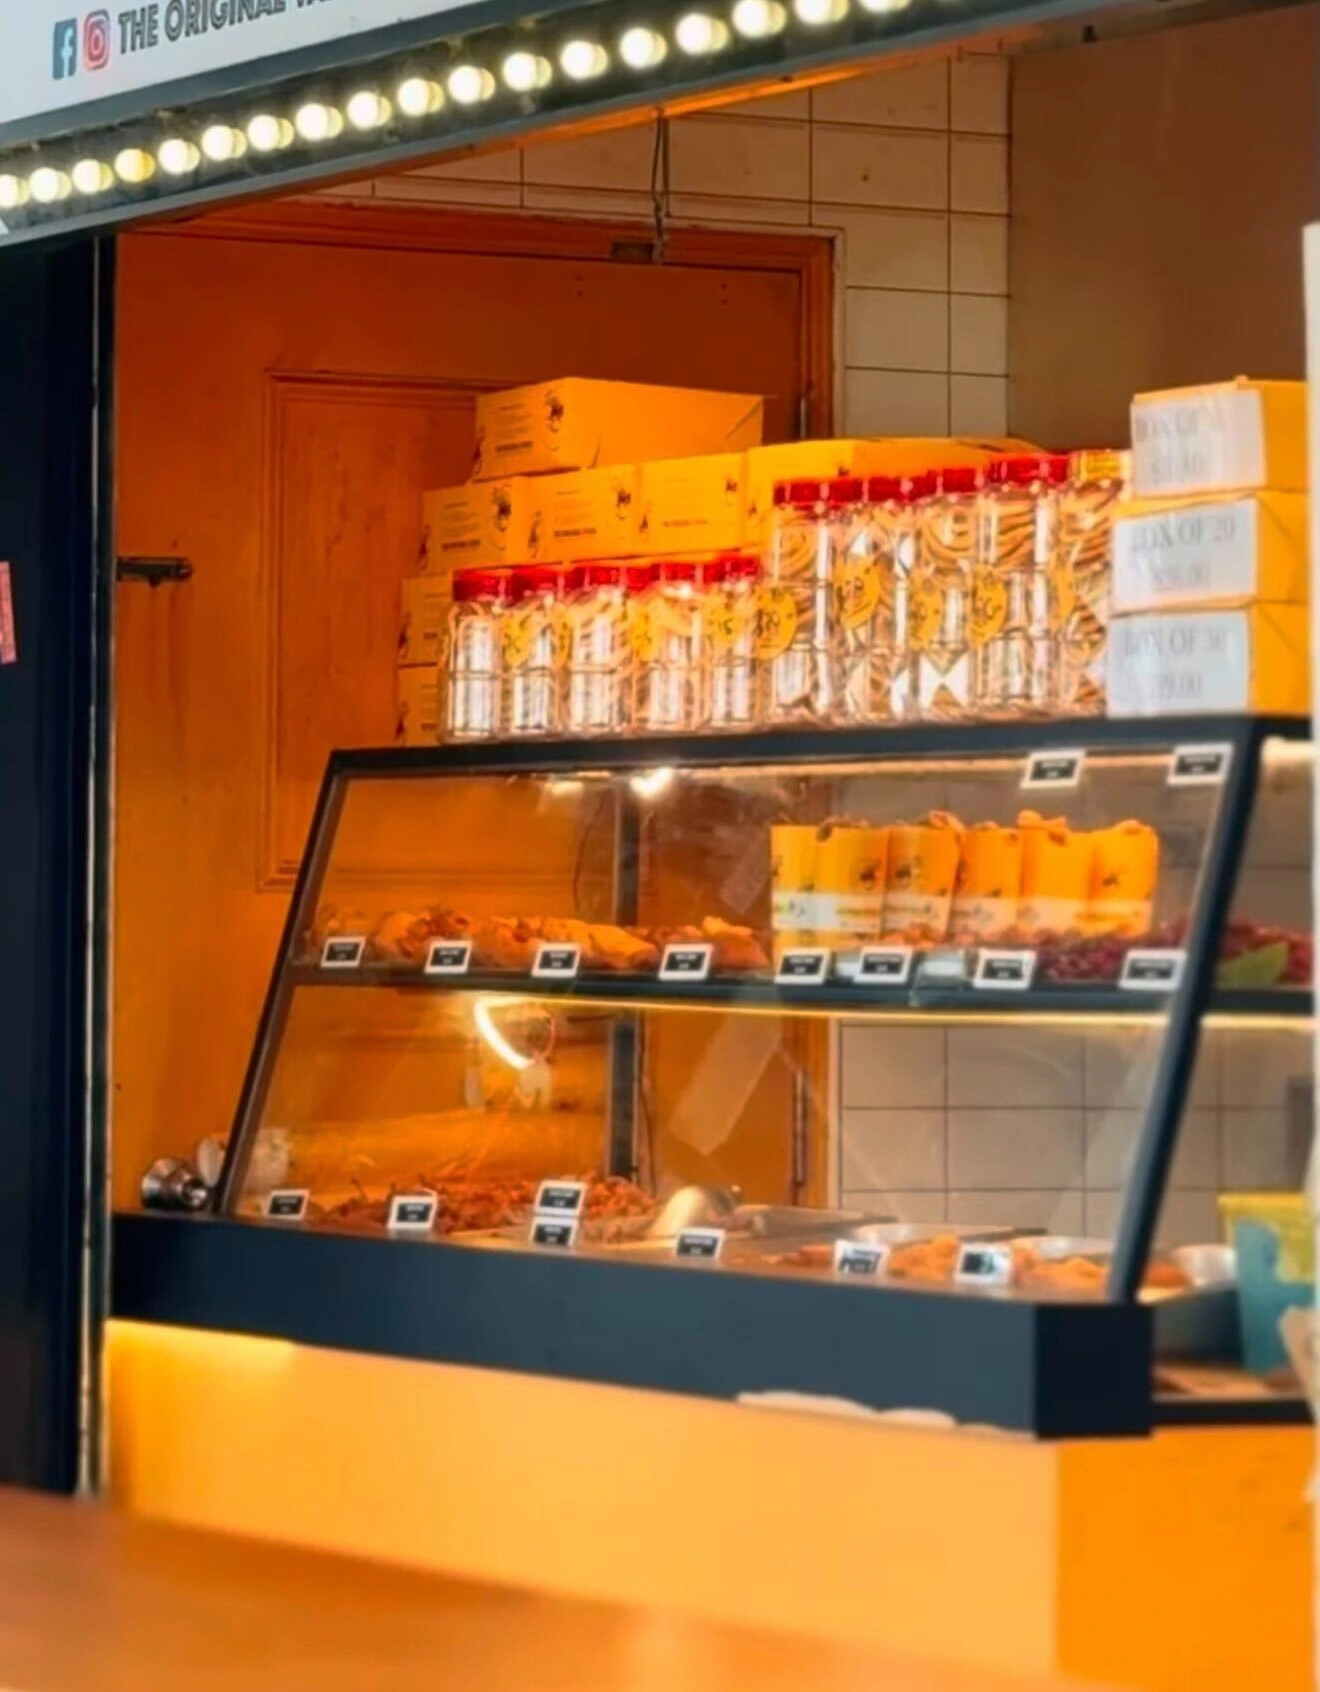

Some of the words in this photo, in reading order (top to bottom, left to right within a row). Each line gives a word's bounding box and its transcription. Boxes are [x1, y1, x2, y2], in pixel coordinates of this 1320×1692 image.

[118, 4, 160, 54] THE
[1177, 515, 1204, 546] OF
[1123, 628, 1162, 657] BOX
[1168, 624, 1196, 656] OF
